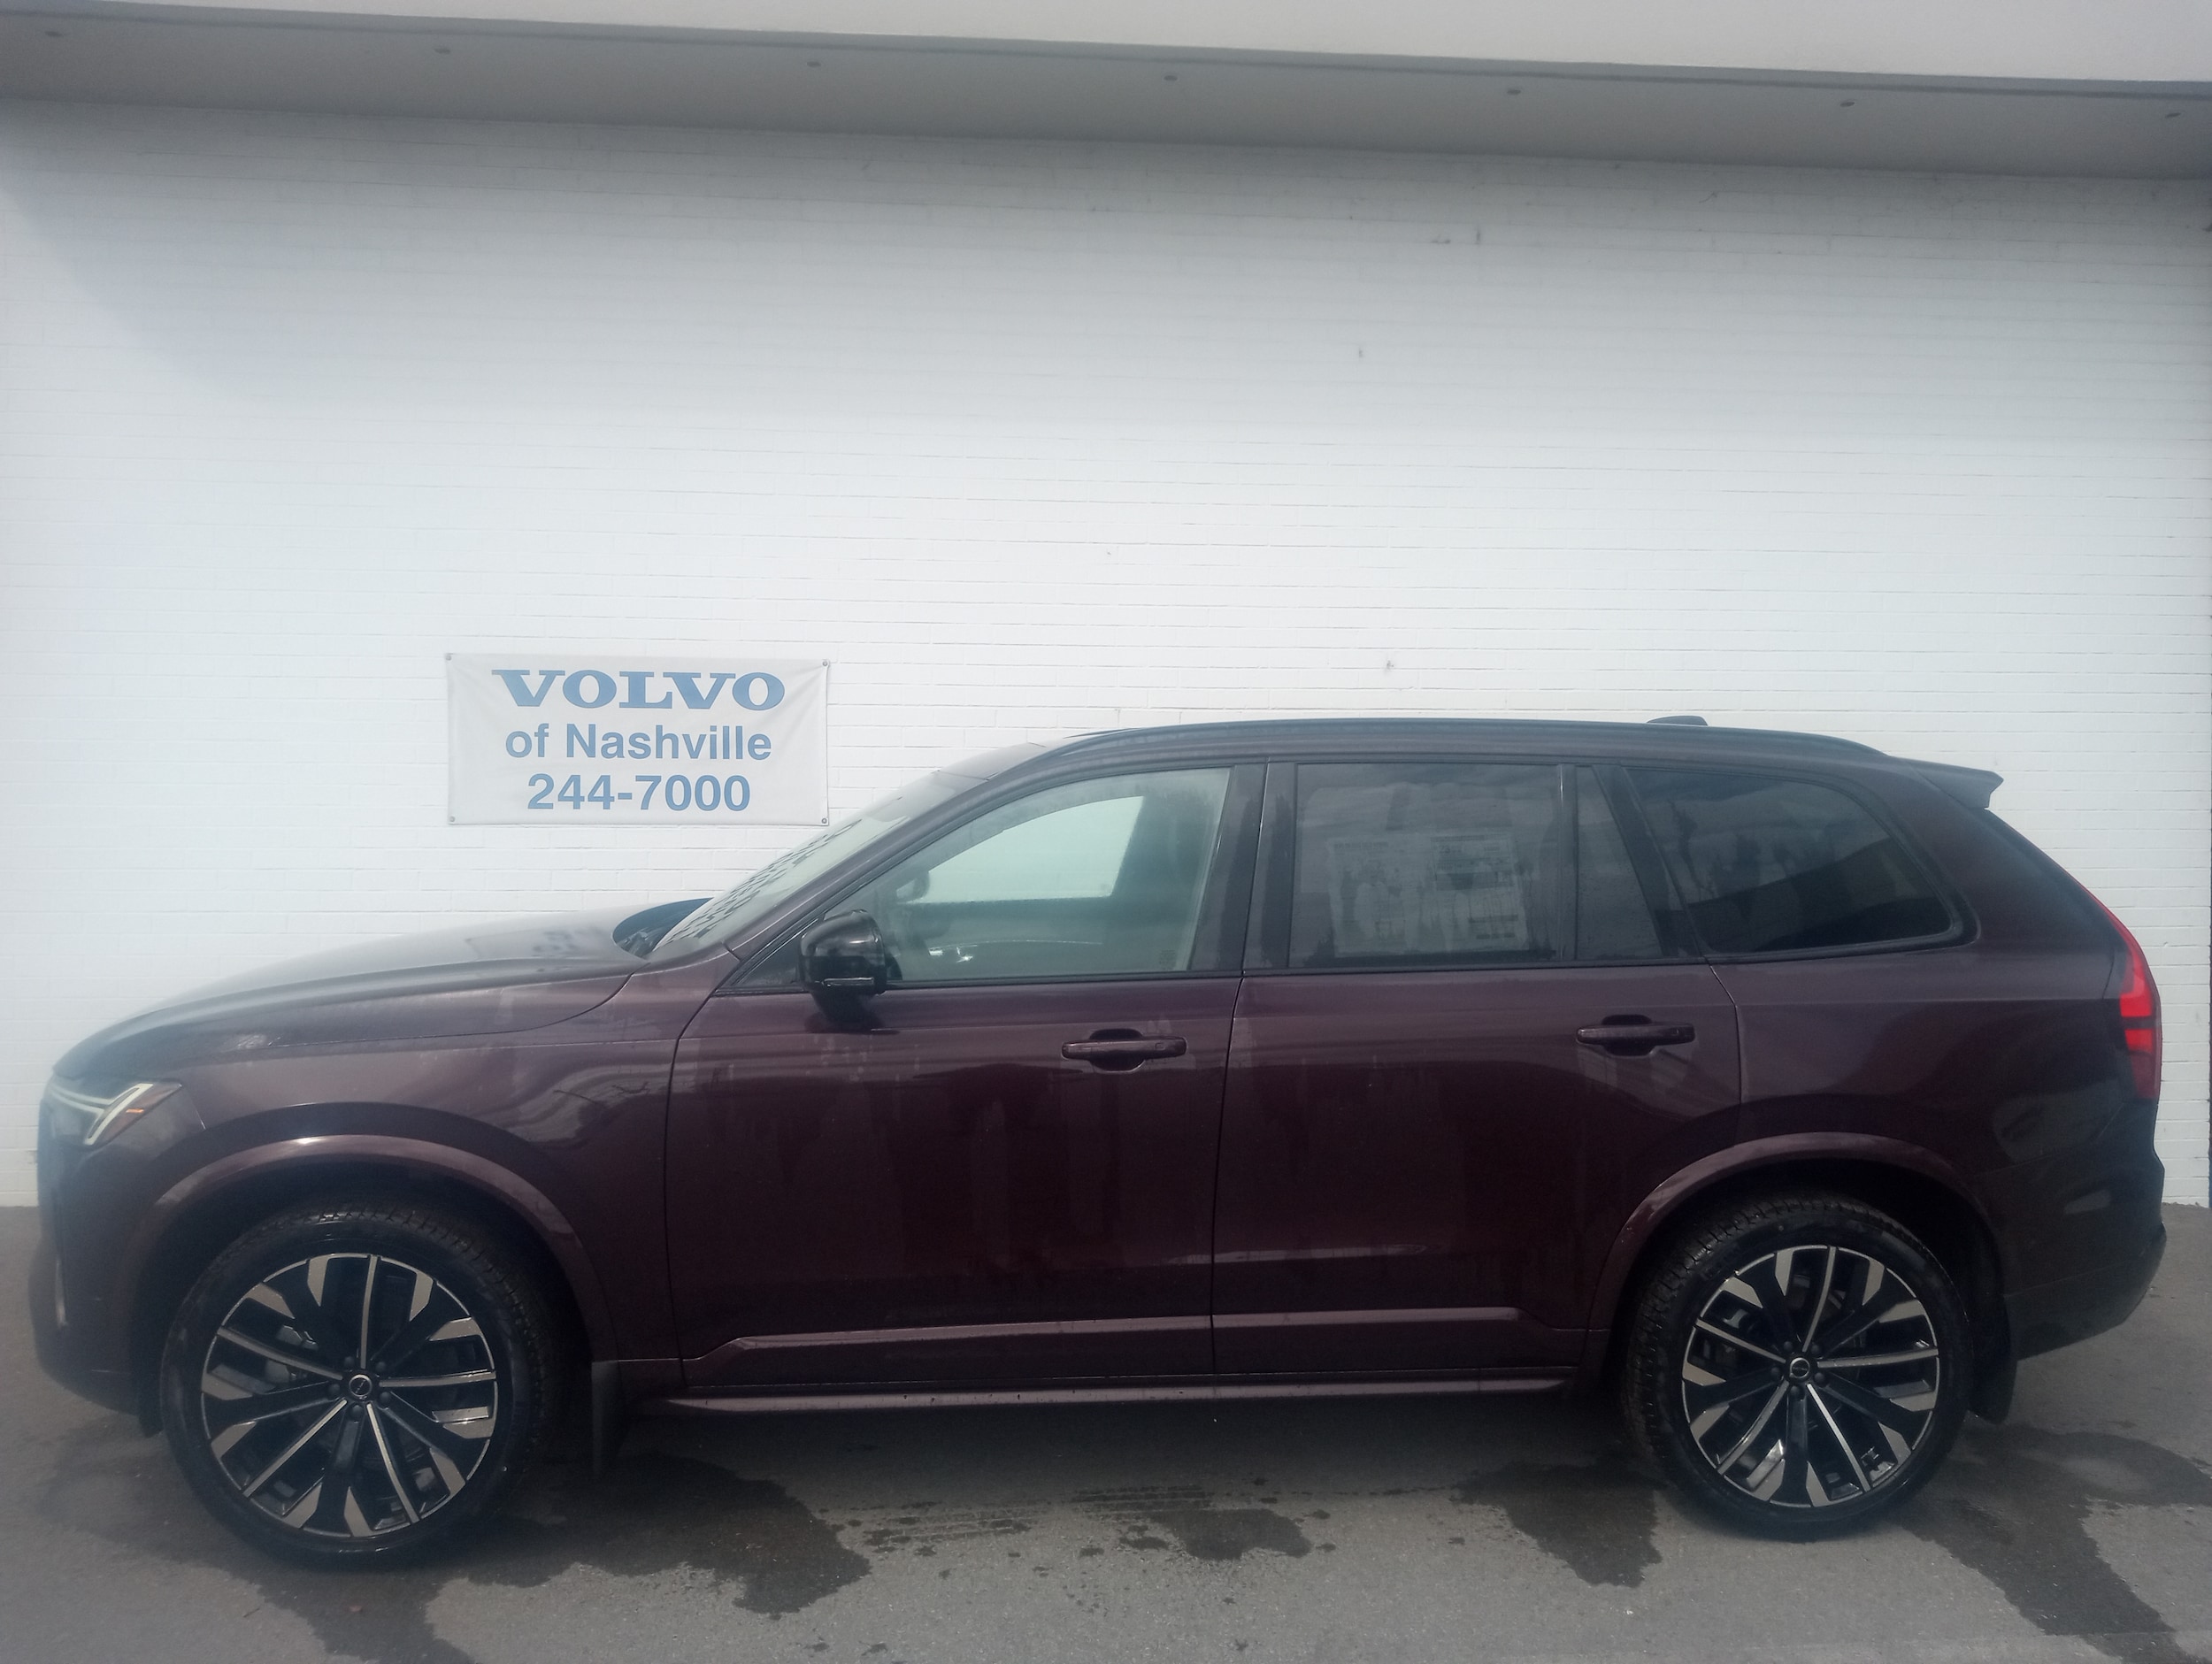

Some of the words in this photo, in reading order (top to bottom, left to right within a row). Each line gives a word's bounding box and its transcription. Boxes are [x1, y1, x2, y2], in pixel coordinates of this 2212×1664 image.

[492, 669, 786, 711] VOLVO
[505, 723, 549, 758] of
[566, 723, 772, 760] Nashville
[528, 773, 751, 811] 244-7000
